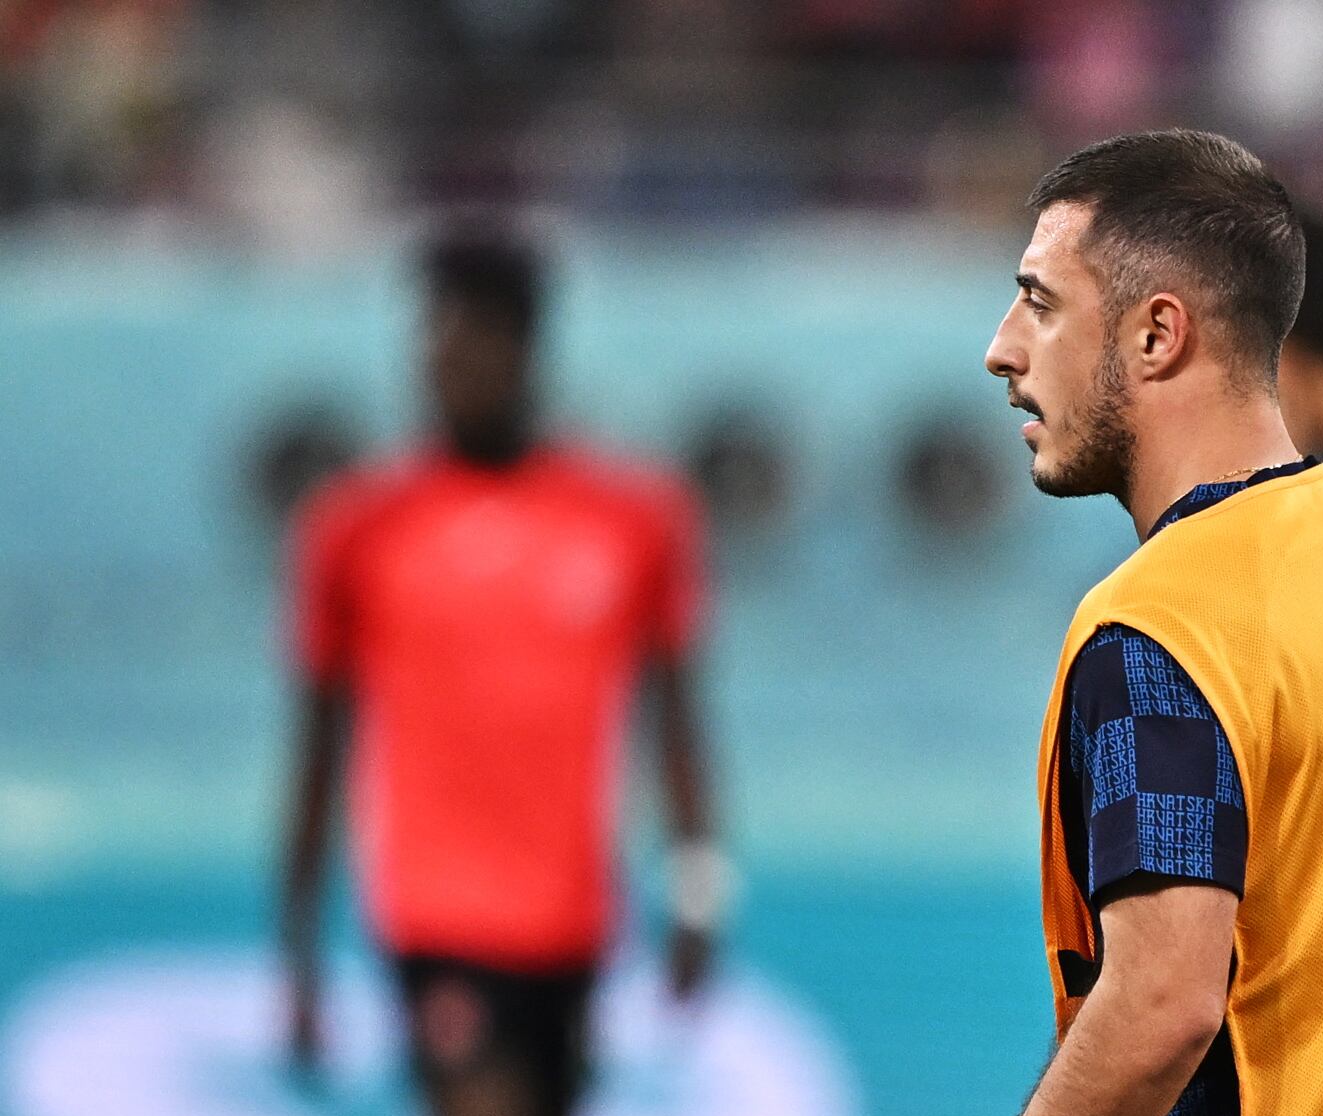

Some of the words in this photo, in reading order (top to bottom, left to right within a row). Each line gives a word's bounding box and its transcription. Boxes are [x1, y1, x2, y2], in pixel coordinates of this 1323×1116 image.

[1136, 792, 1215, 815] HRVATSKA
[1137, 808, 1215, 831] HRVATSKA
[1138, 824, 1214, 847] HRVATSKA
[1139, 840, 1214, 863] HRVATSKA
[1140, 856, 1214, 879] HRVATSKA
